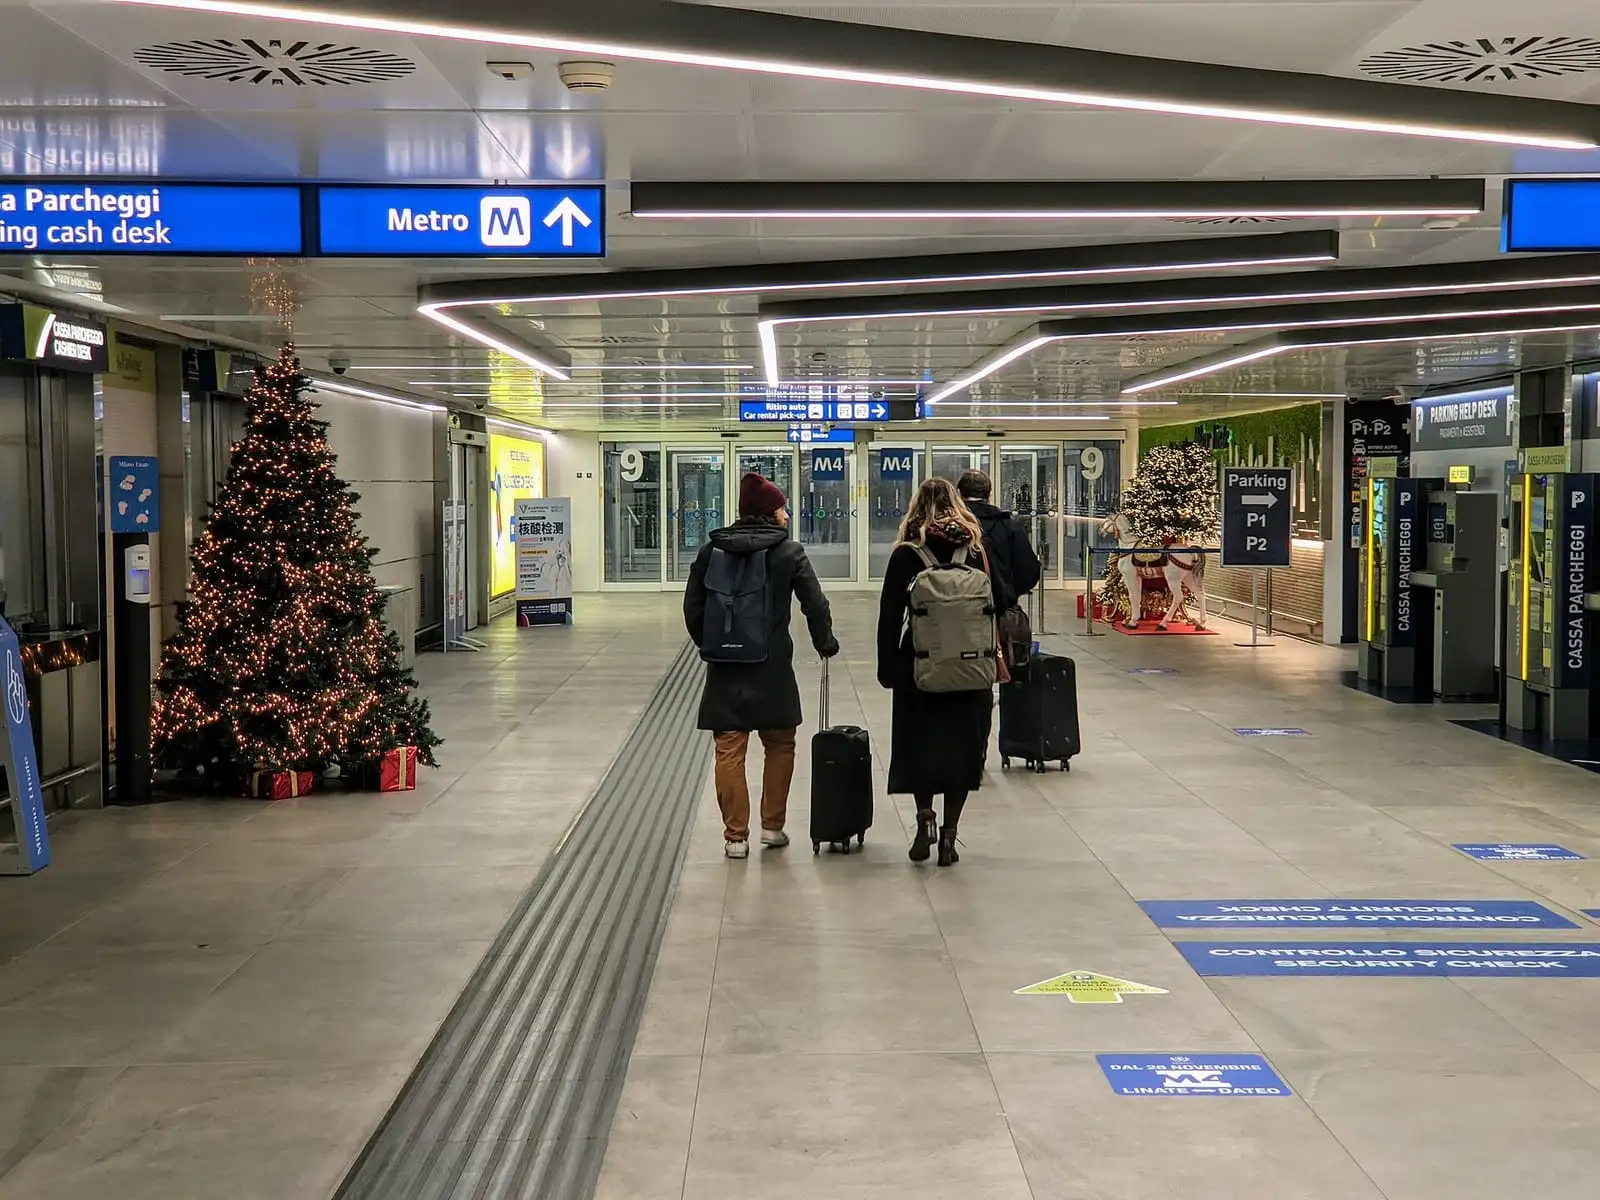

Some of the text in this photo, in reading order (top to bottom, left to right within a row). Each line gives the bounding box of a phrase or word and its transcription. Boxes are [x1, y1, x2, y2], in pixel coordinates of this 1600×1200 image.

[25, 187, 160, 218] Parcheggi
[387, 208, 469, 232] Metro
[47, 219, 103, 243] cash
[112, 219, 171, 244] desk
[53, 320, 71, 339] CASSA
[54, 339, 92, 361] CASHIER DESK
[766, 403, 787, 411] Ritiro
[1430, 404, 1459, 424] PARKING
[1459, 401, 1477, 421] HELP
[1478, 399, 1498, 419] DESK
[743, 411, 807, 420] Car rental pick-up
[620, 448, 644, 482] 9
[814, 456, 843, 472] M4
[882, 456, 912, 472] M4
[1080, 446, 1104, 481] 9
[1228, 473, 1287, 490] Parking
[518, 520, 564, 536] 核酸检测
[1246, 512, 1267, 528] P1
[1246, 535, 1268, 551] P2
[1398, 518, 1412, 631] CASSA PARCHEGGI
[1568, 525, 1586, 669] CASSA PARCHEGGI
[1216, 905, 1475, 913] SECURITY CHECK
[1175, 914, 1541, 922] CONTROLLO SICUREZZA
[1208, 948, 1600, 957] CONTROLLO SICUREZZA
[1273, 959, 1569, 968] SECURITY CHECK
[1122, 1087, 1281, 1095] LINATE DATEO
